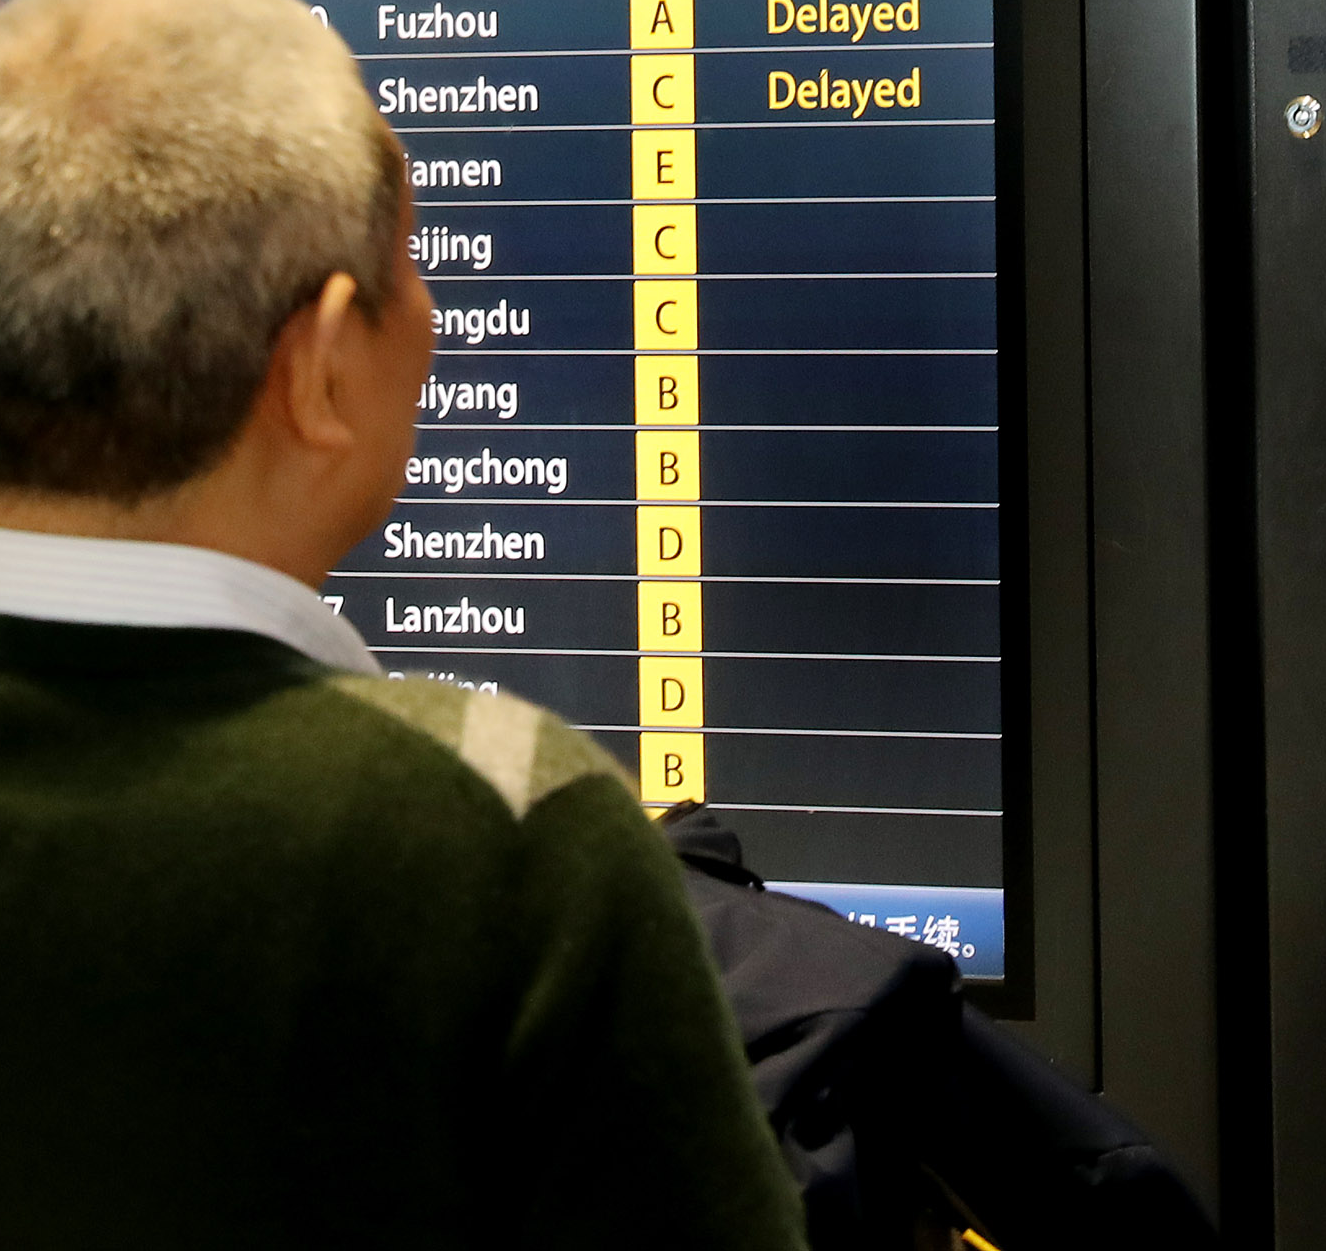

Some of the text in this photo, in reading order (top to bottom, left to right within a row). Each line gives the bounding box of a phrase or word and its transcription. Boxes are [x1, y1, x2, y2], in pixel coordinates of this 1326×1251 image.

[378, 2, 498, 40] Fuzhou
[650, 0, 675, 34] A
[406, 225, 676, 271] eijing C
[404, 447, 680, 494] engchong B
[385, 596, 525, 634] Lanzhou
[662, 602, 682, 637] B
